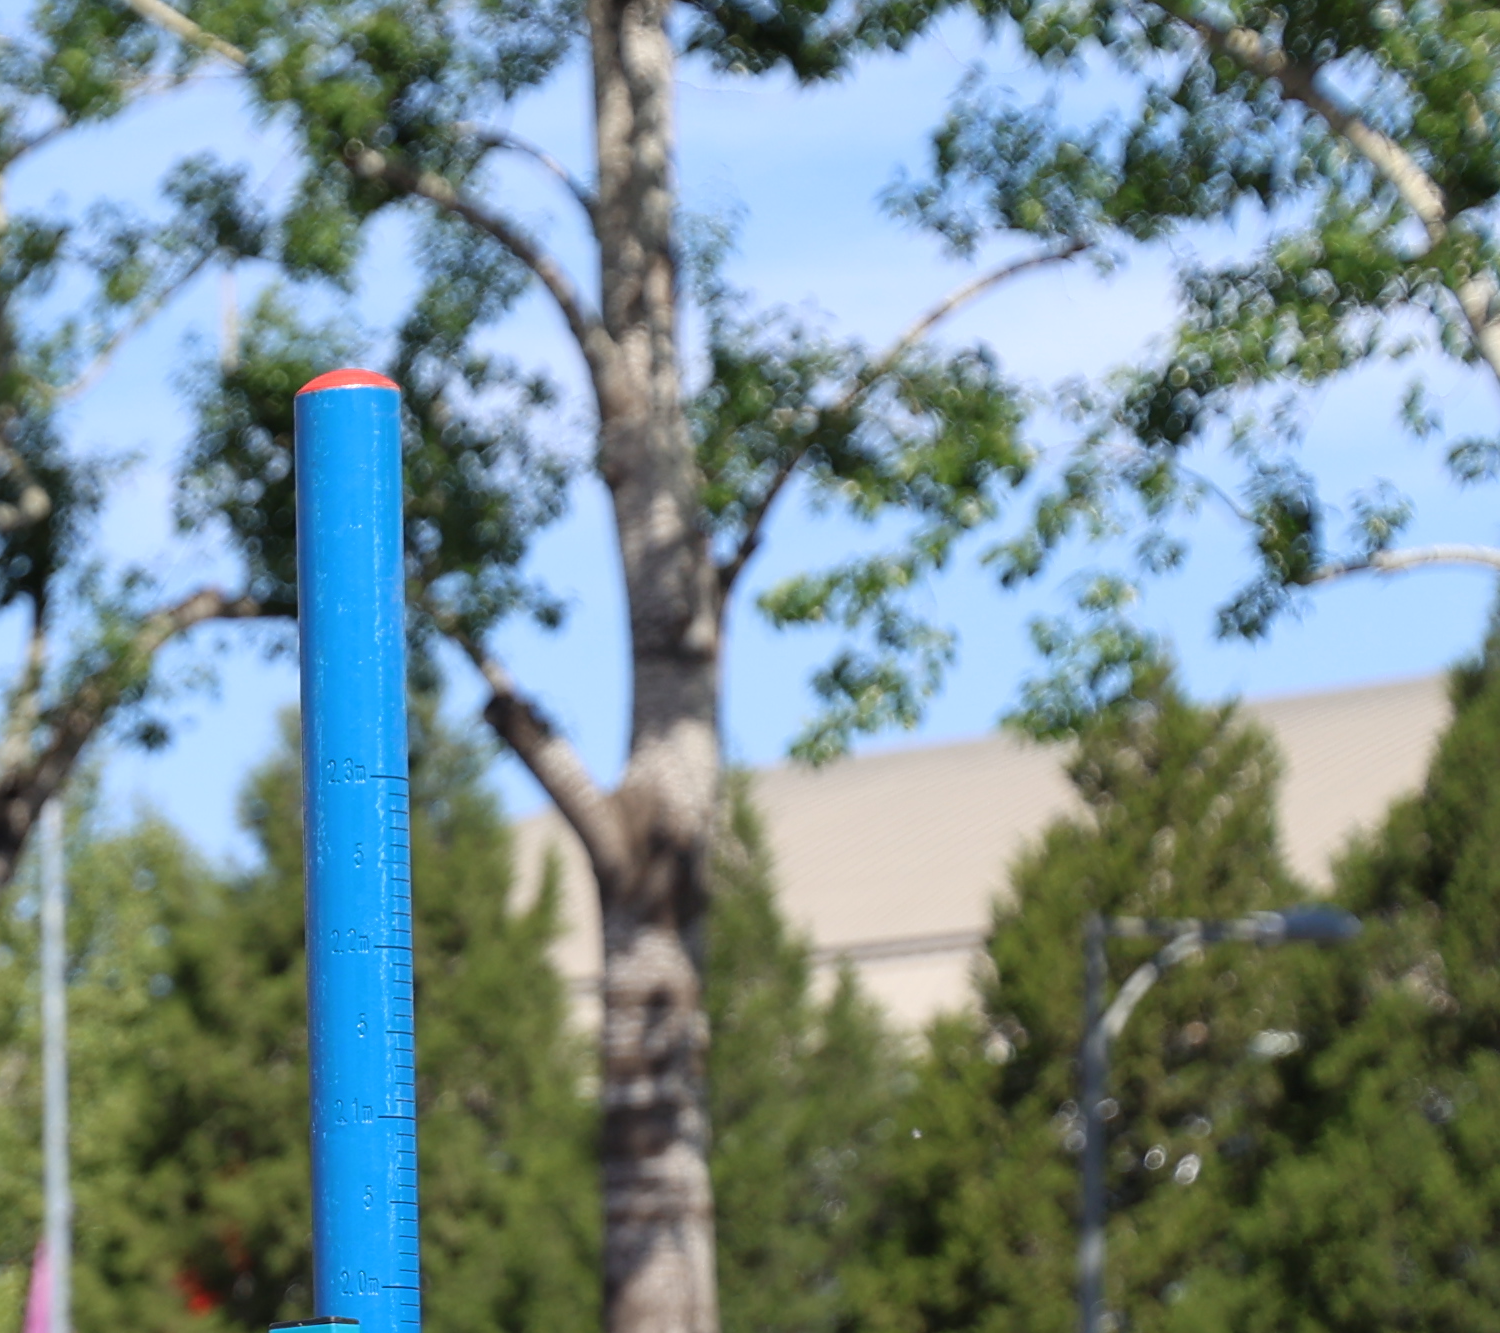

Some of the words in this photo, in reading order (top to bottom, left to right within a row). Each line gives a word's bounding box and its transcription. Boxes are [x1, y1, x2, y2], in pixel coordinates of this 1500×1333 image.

[327, 758, 367, 784] 2.3m
[331, 928, 369, 954] 2.2m
[334, 1098, 373, 1125] 2.1m
[340, 1270, 379, 1296] 2.0m
